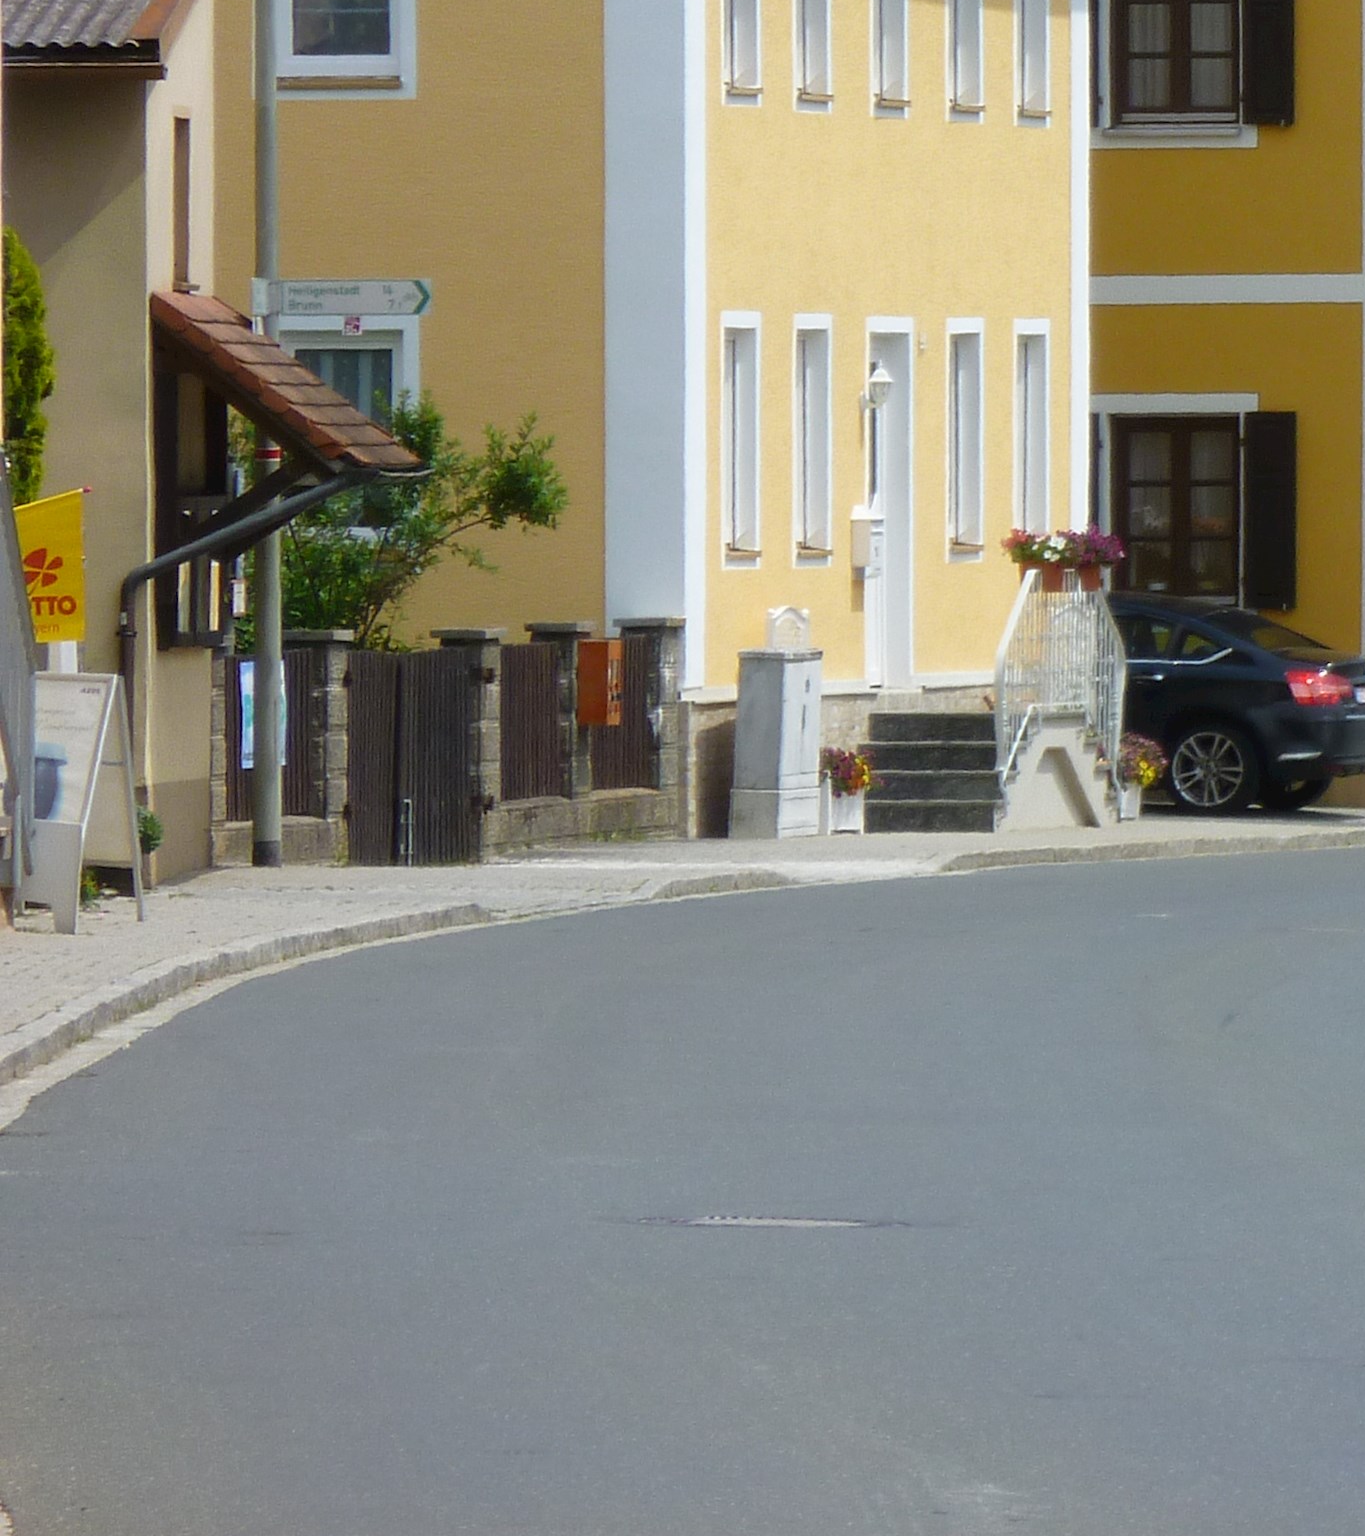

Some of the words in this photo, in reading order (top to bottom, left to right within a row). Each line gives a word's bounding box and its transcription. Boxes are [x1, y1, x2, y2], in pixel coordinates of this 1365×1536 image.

[288, 285, 360, 298] Heiligenstadt
[288, 299, 323, 310] Brunn
[31, 595, 77, 616] TTO
